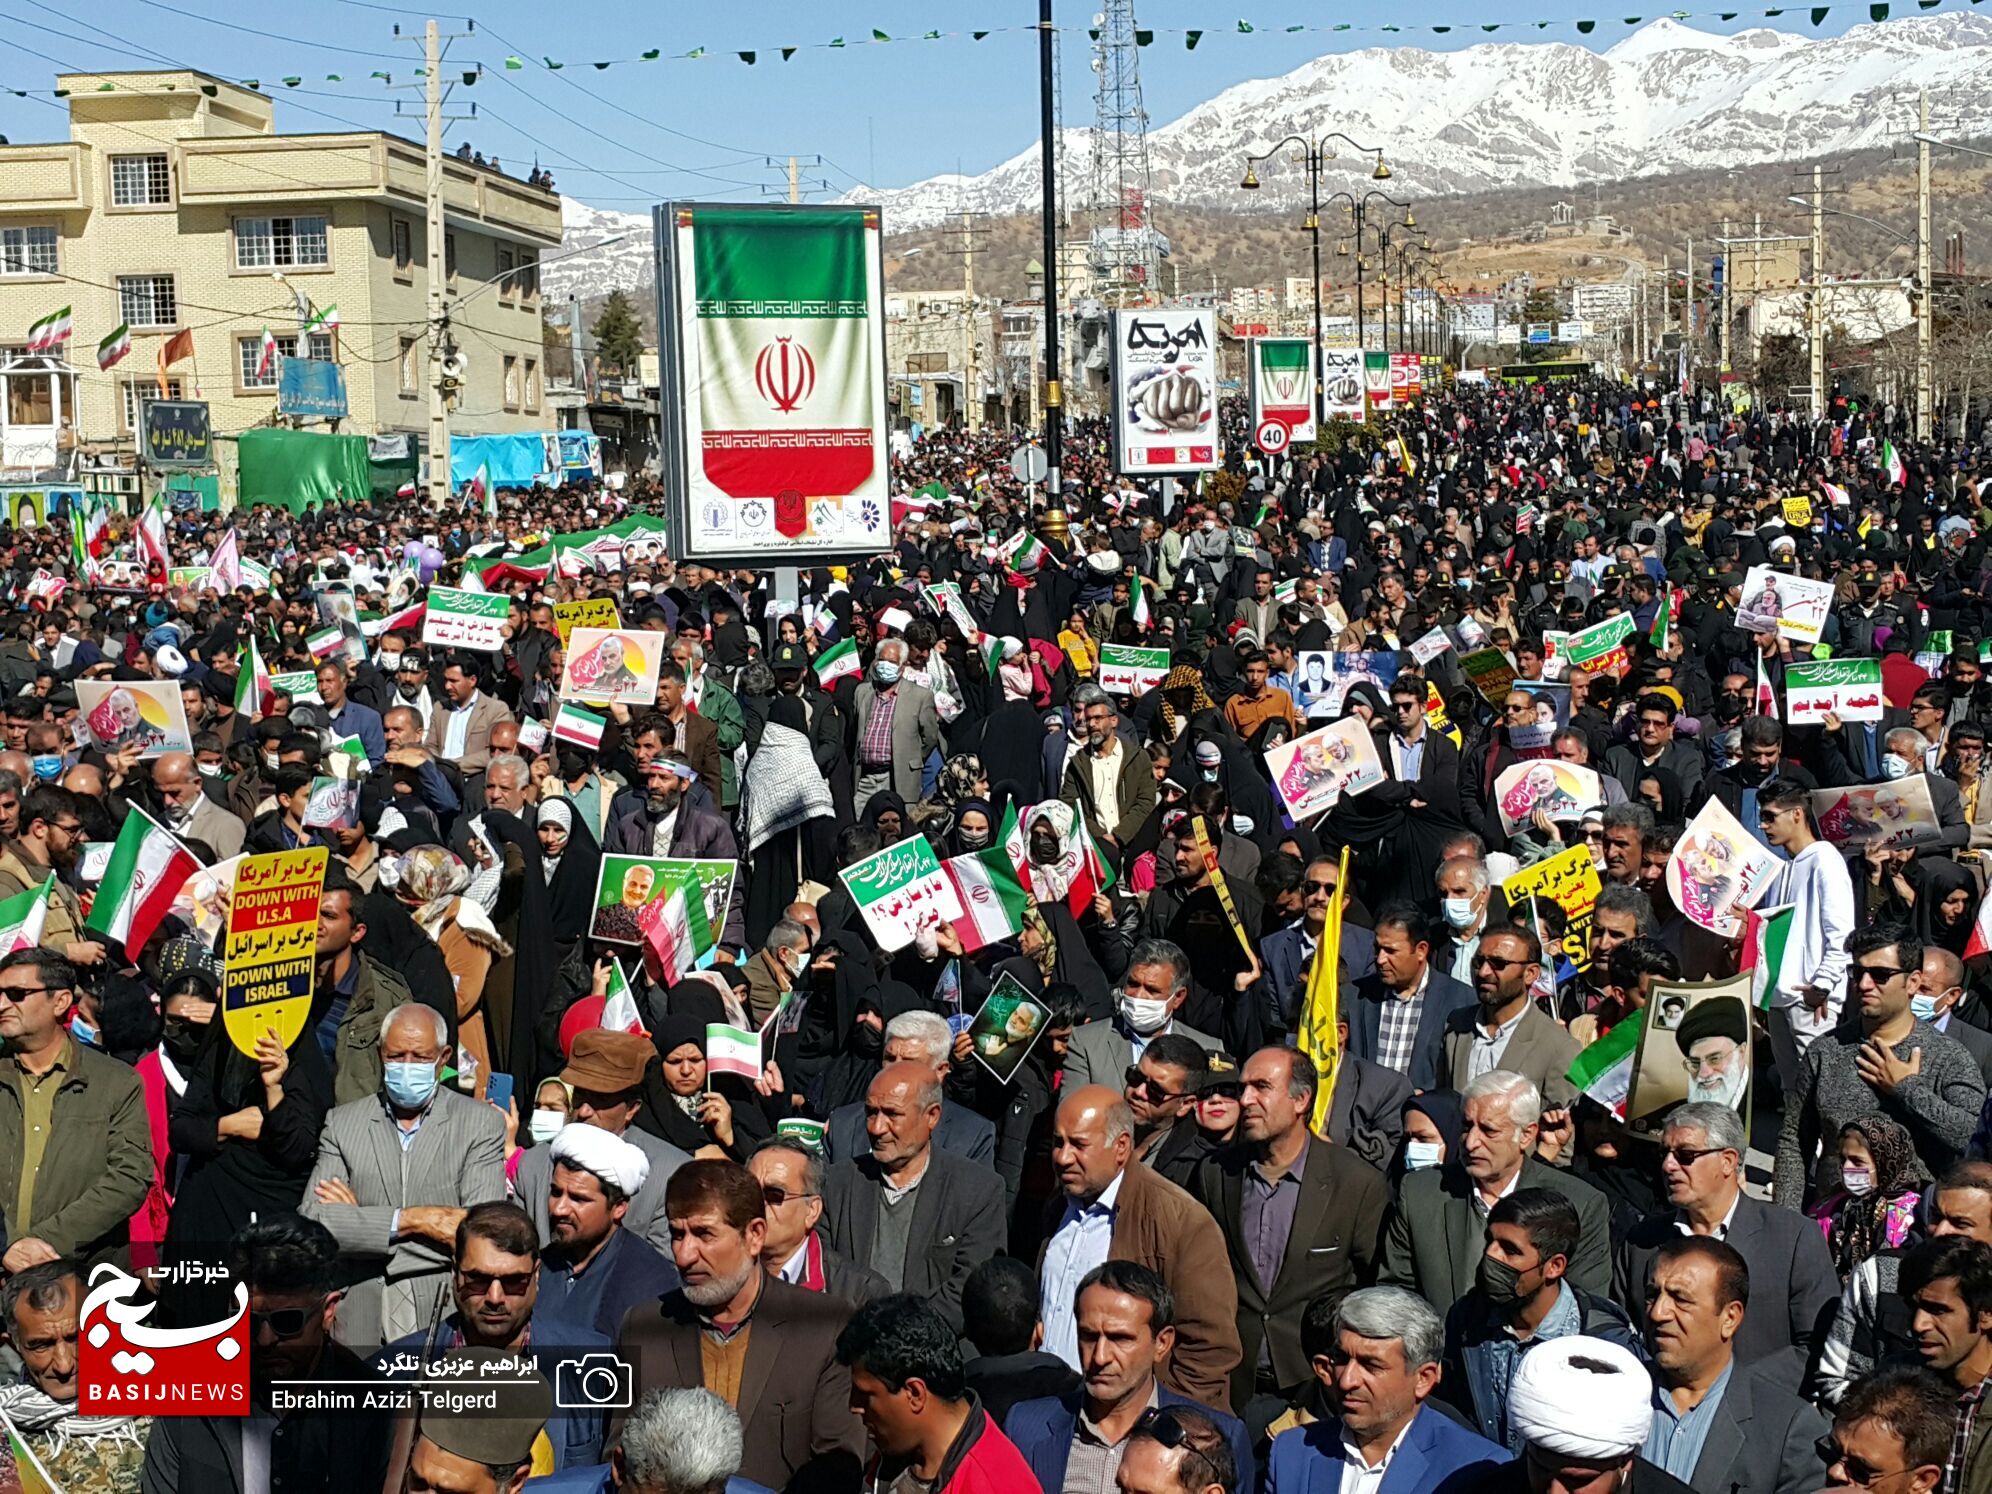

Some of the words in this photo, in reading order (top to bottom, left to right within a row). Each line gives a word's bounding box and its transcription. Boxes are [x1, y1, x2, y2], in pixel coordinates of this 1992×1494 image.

[1263, 430, 1282, 443] 40
[556, 605, 585, 621] آمریکا
[587, 609, 594, 619] بر
[595, 604, 615, 617] مرگ
[623, 681, 638, 693] ۲۲
[1792, 691, 1838, 716] آمدیم
[1846, 694, 1879, 708] همه
[149, 734, 165, 747] ۲۲
[1346, 768, 1361, 784] ۲۲
[1562, 801, 1578, 811] ۲۲
[1895, 828, 1914, 841] ۲۲
[239, 858, 281, 887] آمریکا
[280, 863, 294, 883] بر
[294, 856, 324, 881] مرگ
[1563, 858, 1591, 877] مرگ
[1740, 862, 1757, 883] ۲۲
[928, 877, 943, 892] ما
[1508, 869, 1549, 901] آمریکا
[1552, 871, 1563, 889] بر
[1563, 880, 1587, 899] یعنی
[235, 890, 281, 910] DOWN
[282, 884, 319, 901] WITH
[925, 884, 933, 900] و
[888, 887, 923, 918] سازش
[256, 907, 292, 925] U.S.A
[227, 931, 273, 961] اسرائیل
[273, 933, 286, 954] بر
[289, 926, 315, 949] مرگ
[228, 966, 273, 988] DOWN
[275, 958, 311, 979] WITH
[245, 982, 291, 1003] ISRAEL
